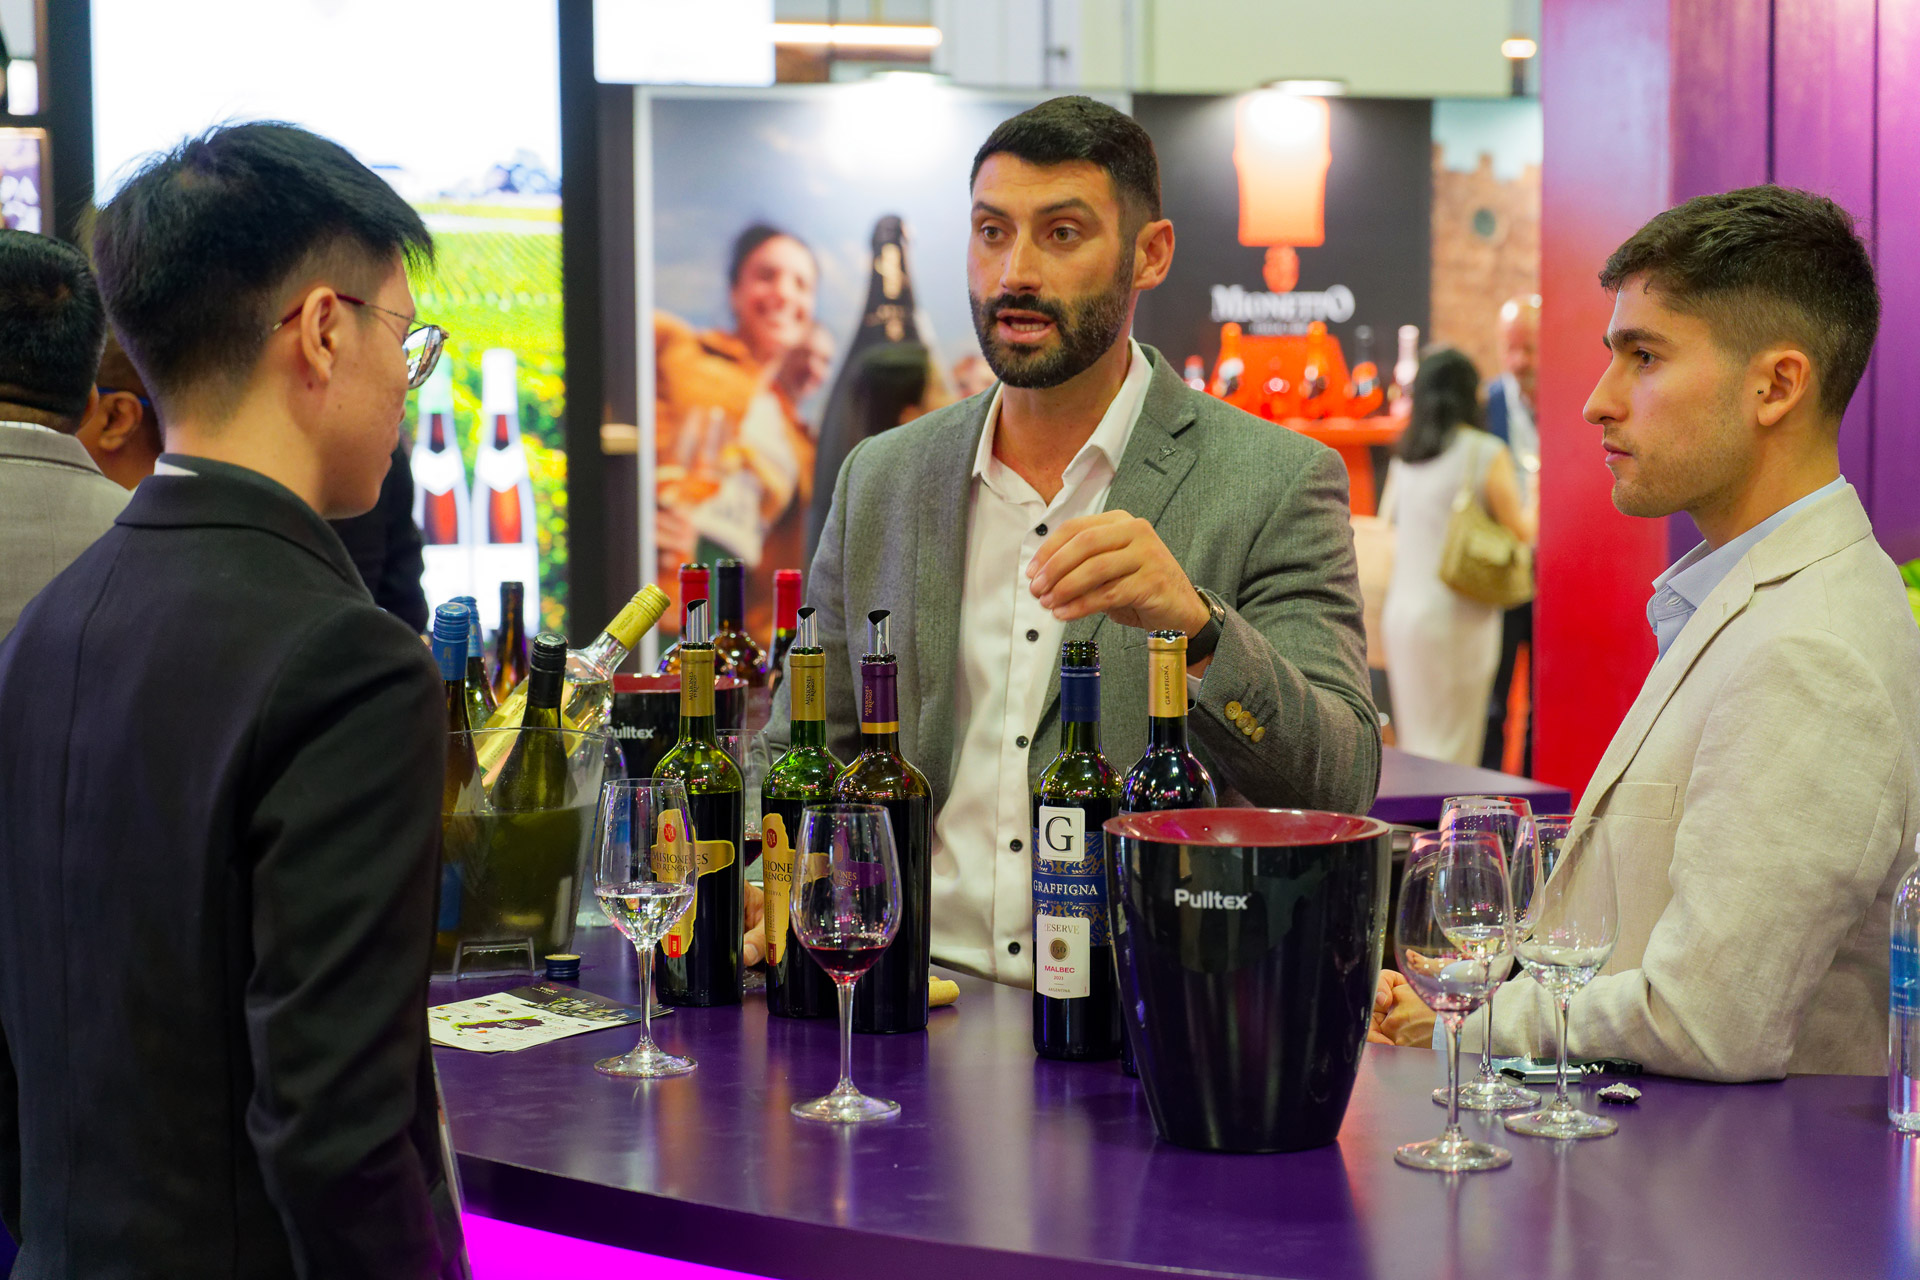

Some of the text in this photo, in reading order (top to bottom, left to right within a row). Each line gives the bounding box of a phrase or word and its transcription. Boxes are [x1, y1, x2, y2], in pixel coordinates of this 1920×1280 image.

[1163, 665, 1171, 705] GRAFFIGNA
[1045, 815, 1074, 852] G
[1033, 880, 1098, 896] GRAFFIGNA
[1174, 888, 1248, 910] Pulltex
[1044, 923, 1080, 935] ESERVE
[1044, 965, 1076, 974] MALBEC
